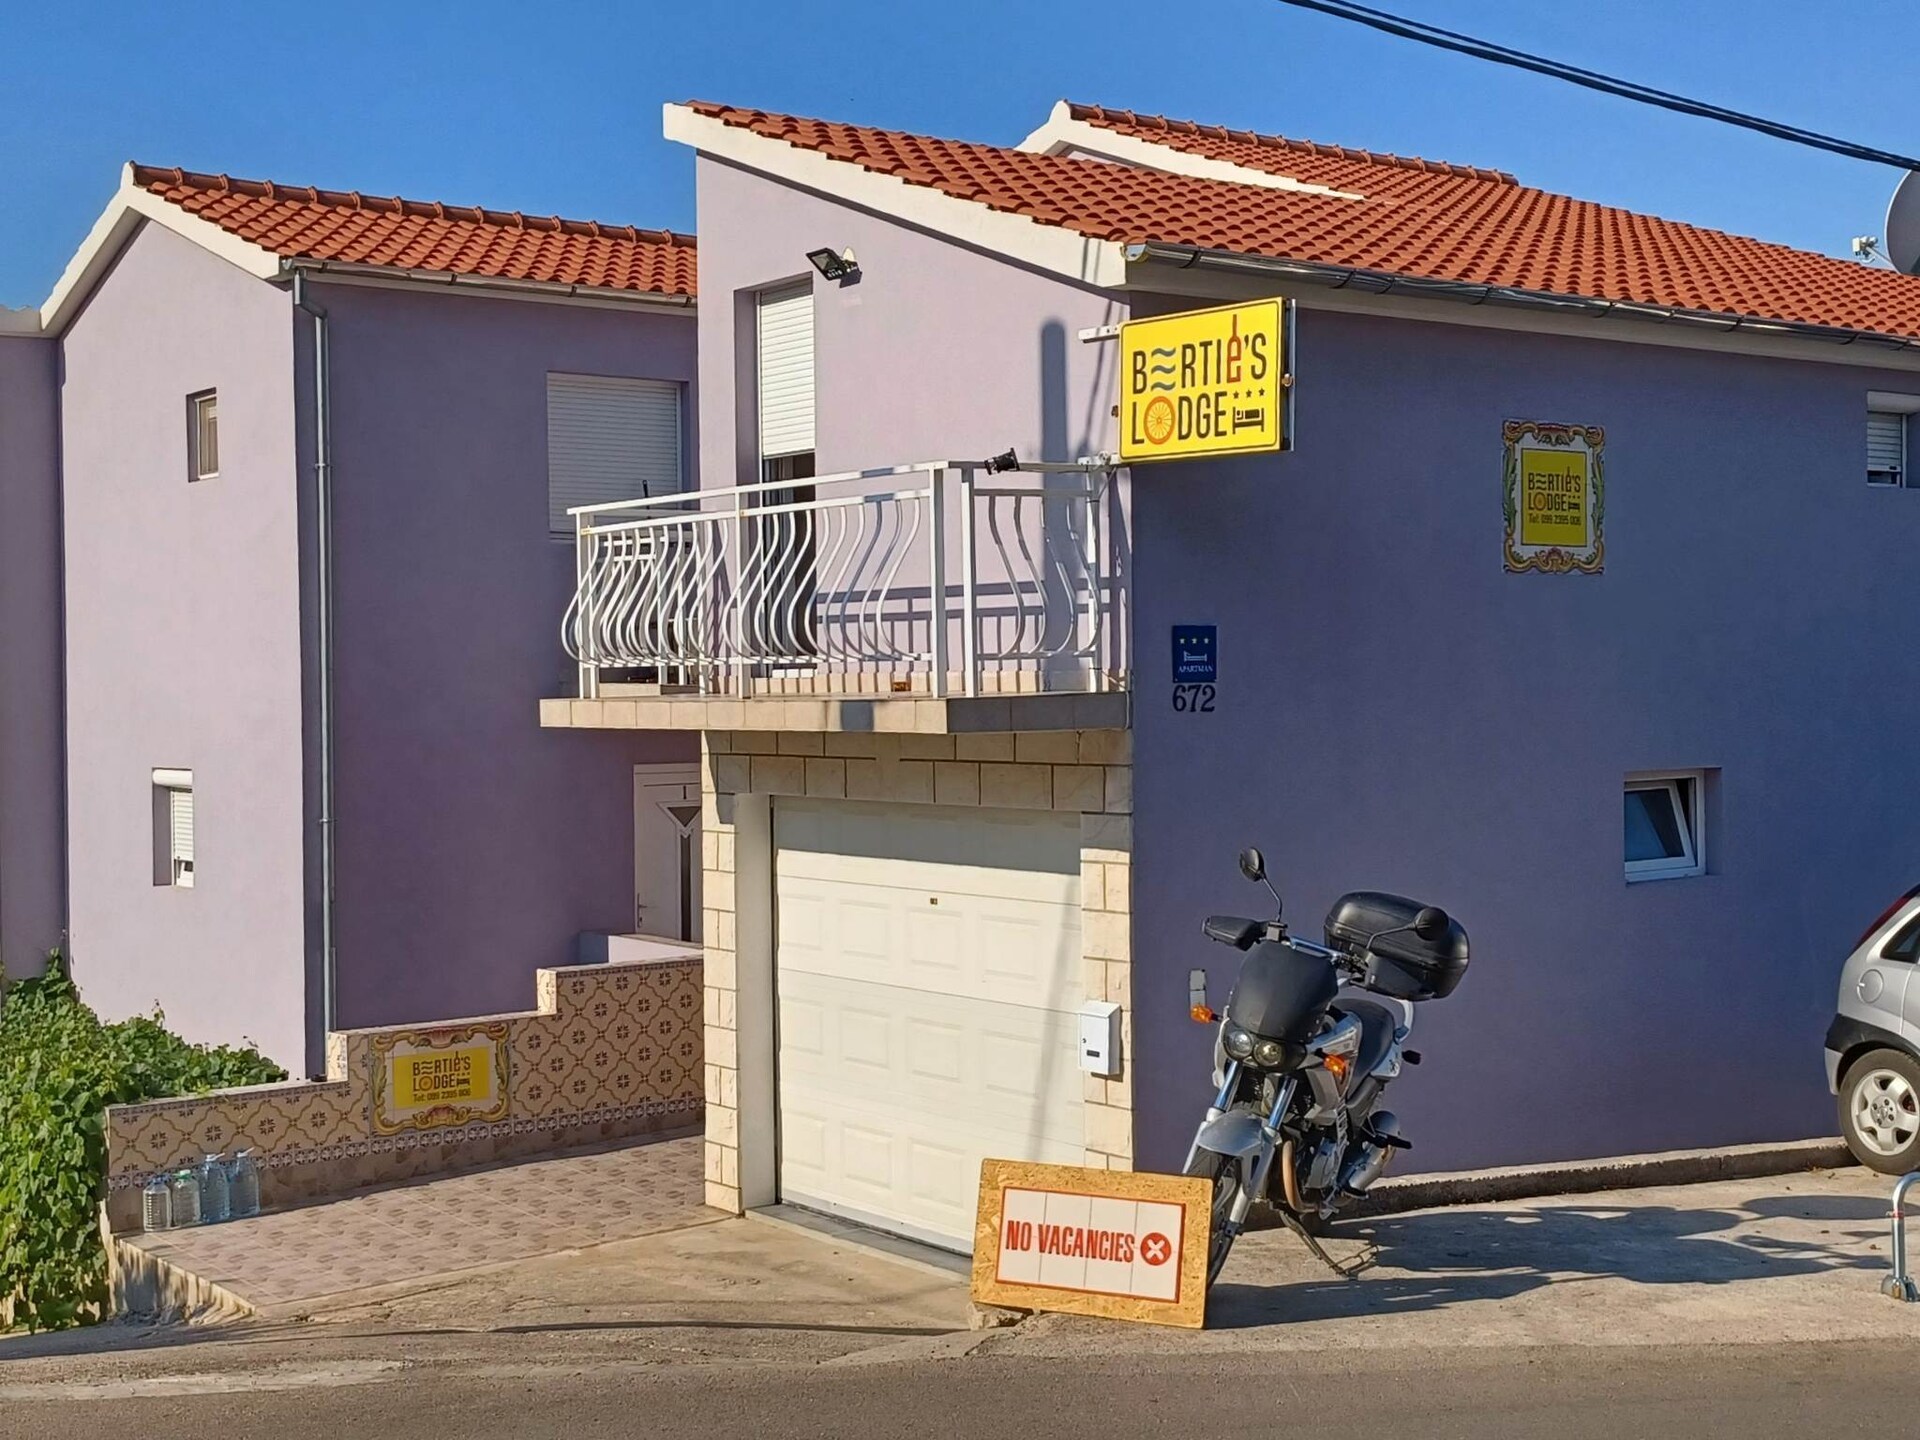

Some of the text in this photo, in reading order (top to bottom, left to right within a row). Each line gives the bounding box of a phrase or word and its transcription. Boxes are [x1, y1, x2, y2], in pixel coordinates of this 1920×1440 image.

[1132, 391, 1228, 445] LODGE
[1528, 492, 1567, 511] LODGE
[1172, 684, 1216, 713] 672
[413, 1073, 456, 1092] LODGE
[1005, 1220, 1136, 1263] NO VACANCIES
